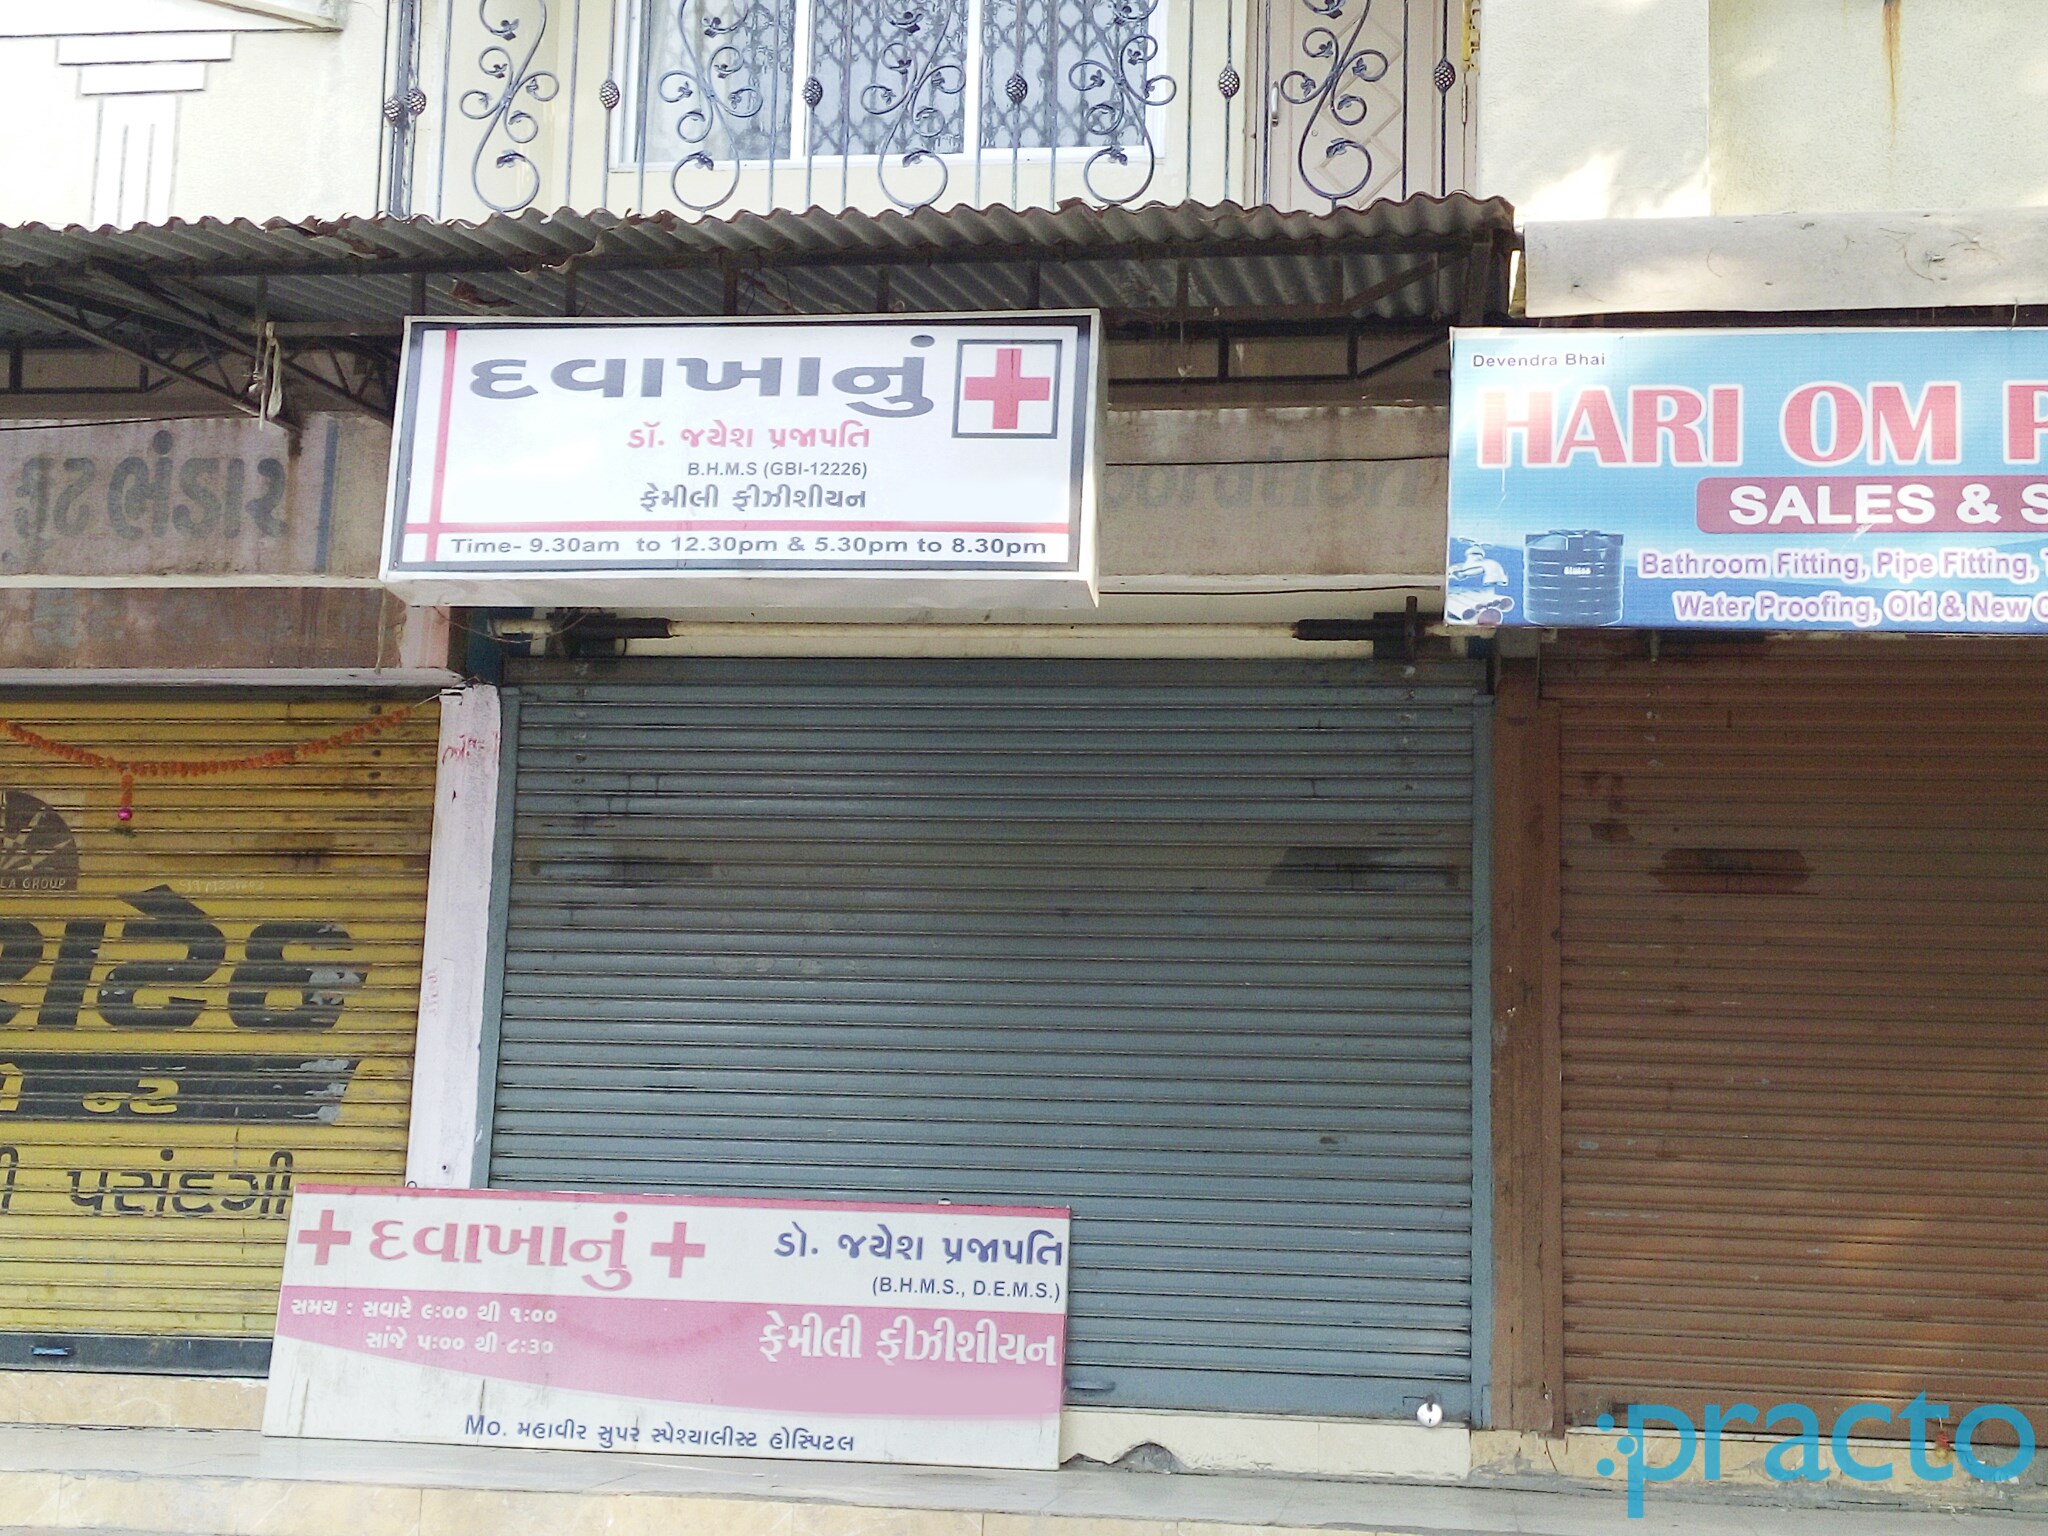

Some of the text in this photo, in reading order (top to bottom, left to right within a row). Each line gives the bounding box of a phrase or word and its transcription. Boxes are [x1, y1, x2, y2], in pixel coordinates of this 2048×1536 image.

[1473, 353, 1605, 367] Devendra Bhai
[471, 335, 936, 418] દવાખાનું
[680, 419, 754, 449] જયેશ
[768, 420, 870, 449] પ્રજાપતિ
[1478, 384, 1742, 467] HARI
[1780, 382, 1960, 466] OM
[687, 462, 868, 479] B.H.M.S (GBI-12226)
[640, 482, 867, 512] ફેમીલી ફીઝીશીયન
[1729, 484, 1936, 526] SALES
[1956, 484, 2002, 525] &
[451, 536, 1046, 557] Time- 9.30am to 12.30pm & 5.30pm to 8.30pm
[1641, 552, 1767, 575] Bathroom
[1776, 552, 1869, 580] Fitting,
[1876, 552, 1934, 579] Pipe
[1943, 552, 2037, 580] Fitting,
[1675, 594, 1752, 619] Water
[1758, 594, 1882, 623] Proofing,
[1887, 594, 1933, 619] Old
[1941, 595, 1962, 619] &
[1970, 595, 2028, 618] New
[22, 878, 66, 889] GROUP
[368, 1210, 633, 1292] દવાખાનું
[774, 1222, 1064, 1267] ડો. જયેશ પ્રજાપતિ
[872, 1276, 1061, 1303] (B.H.M.S., D.E.M.S.)
[291, 1298, 337, 1317] સમય
[362, 1296, 412, 1319] સવારે
[477, 1301, 501, 1323] થી
[366, 1325, 408, 1351] સાંજે
[474, 1331, 499, 1354] થી
[758, 1310, 1058, 1367] ફેમીલી ફીઝીશીયન
[465, 1414, 508, 1438] Mo.
[517, 1418, 587, 1440] મહાવીર
[597, 1424, 641, 1449] સુપર
